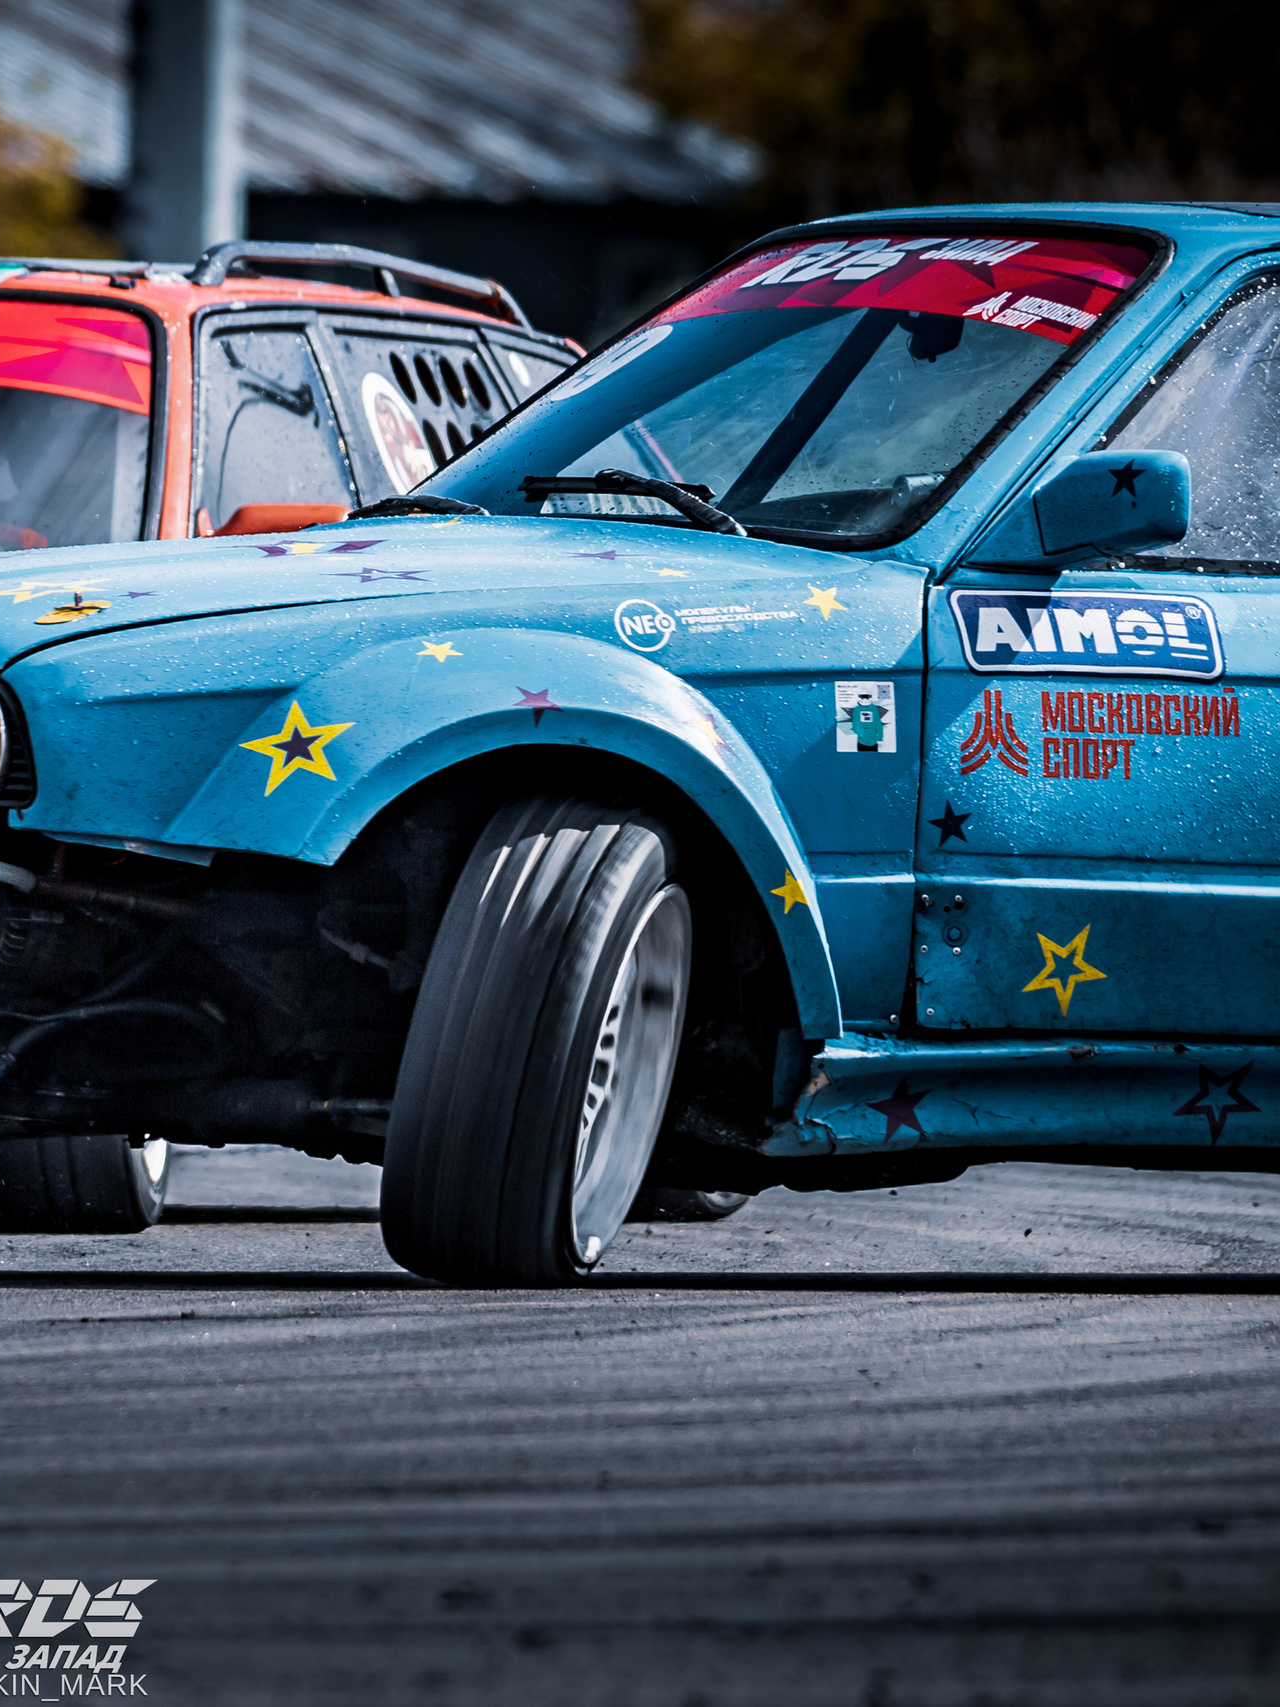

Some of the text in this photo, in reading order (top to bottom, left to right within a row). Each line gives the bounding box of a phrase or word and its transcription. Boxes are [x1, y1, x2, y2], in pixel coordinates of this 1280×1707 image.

[740, 238, 951, 288] RDS
[976, 606, 1210, 661] AIMOL
[1041, 687, 1240, 737] МОСКОВСКИЙ
[1042, 736, 1136, 780] СПОРТ
